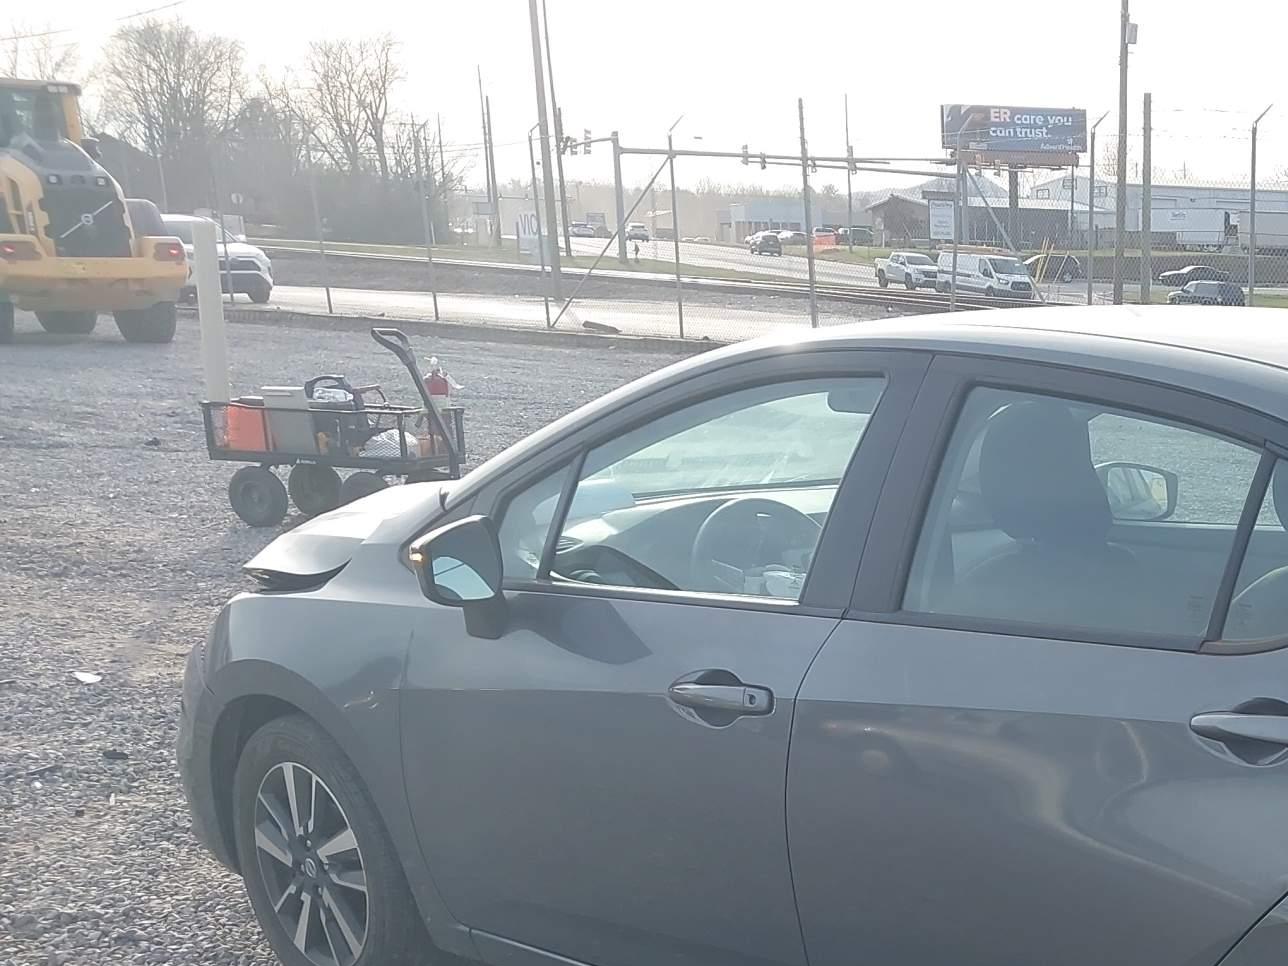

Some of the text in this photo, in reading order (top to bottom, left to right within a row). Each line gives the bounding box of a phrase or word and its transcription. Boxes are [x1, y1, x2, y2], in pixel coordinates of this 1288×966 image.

[990, 108, 1072, 128] ER care you
[989, 126, 1051, 138] can trust.
